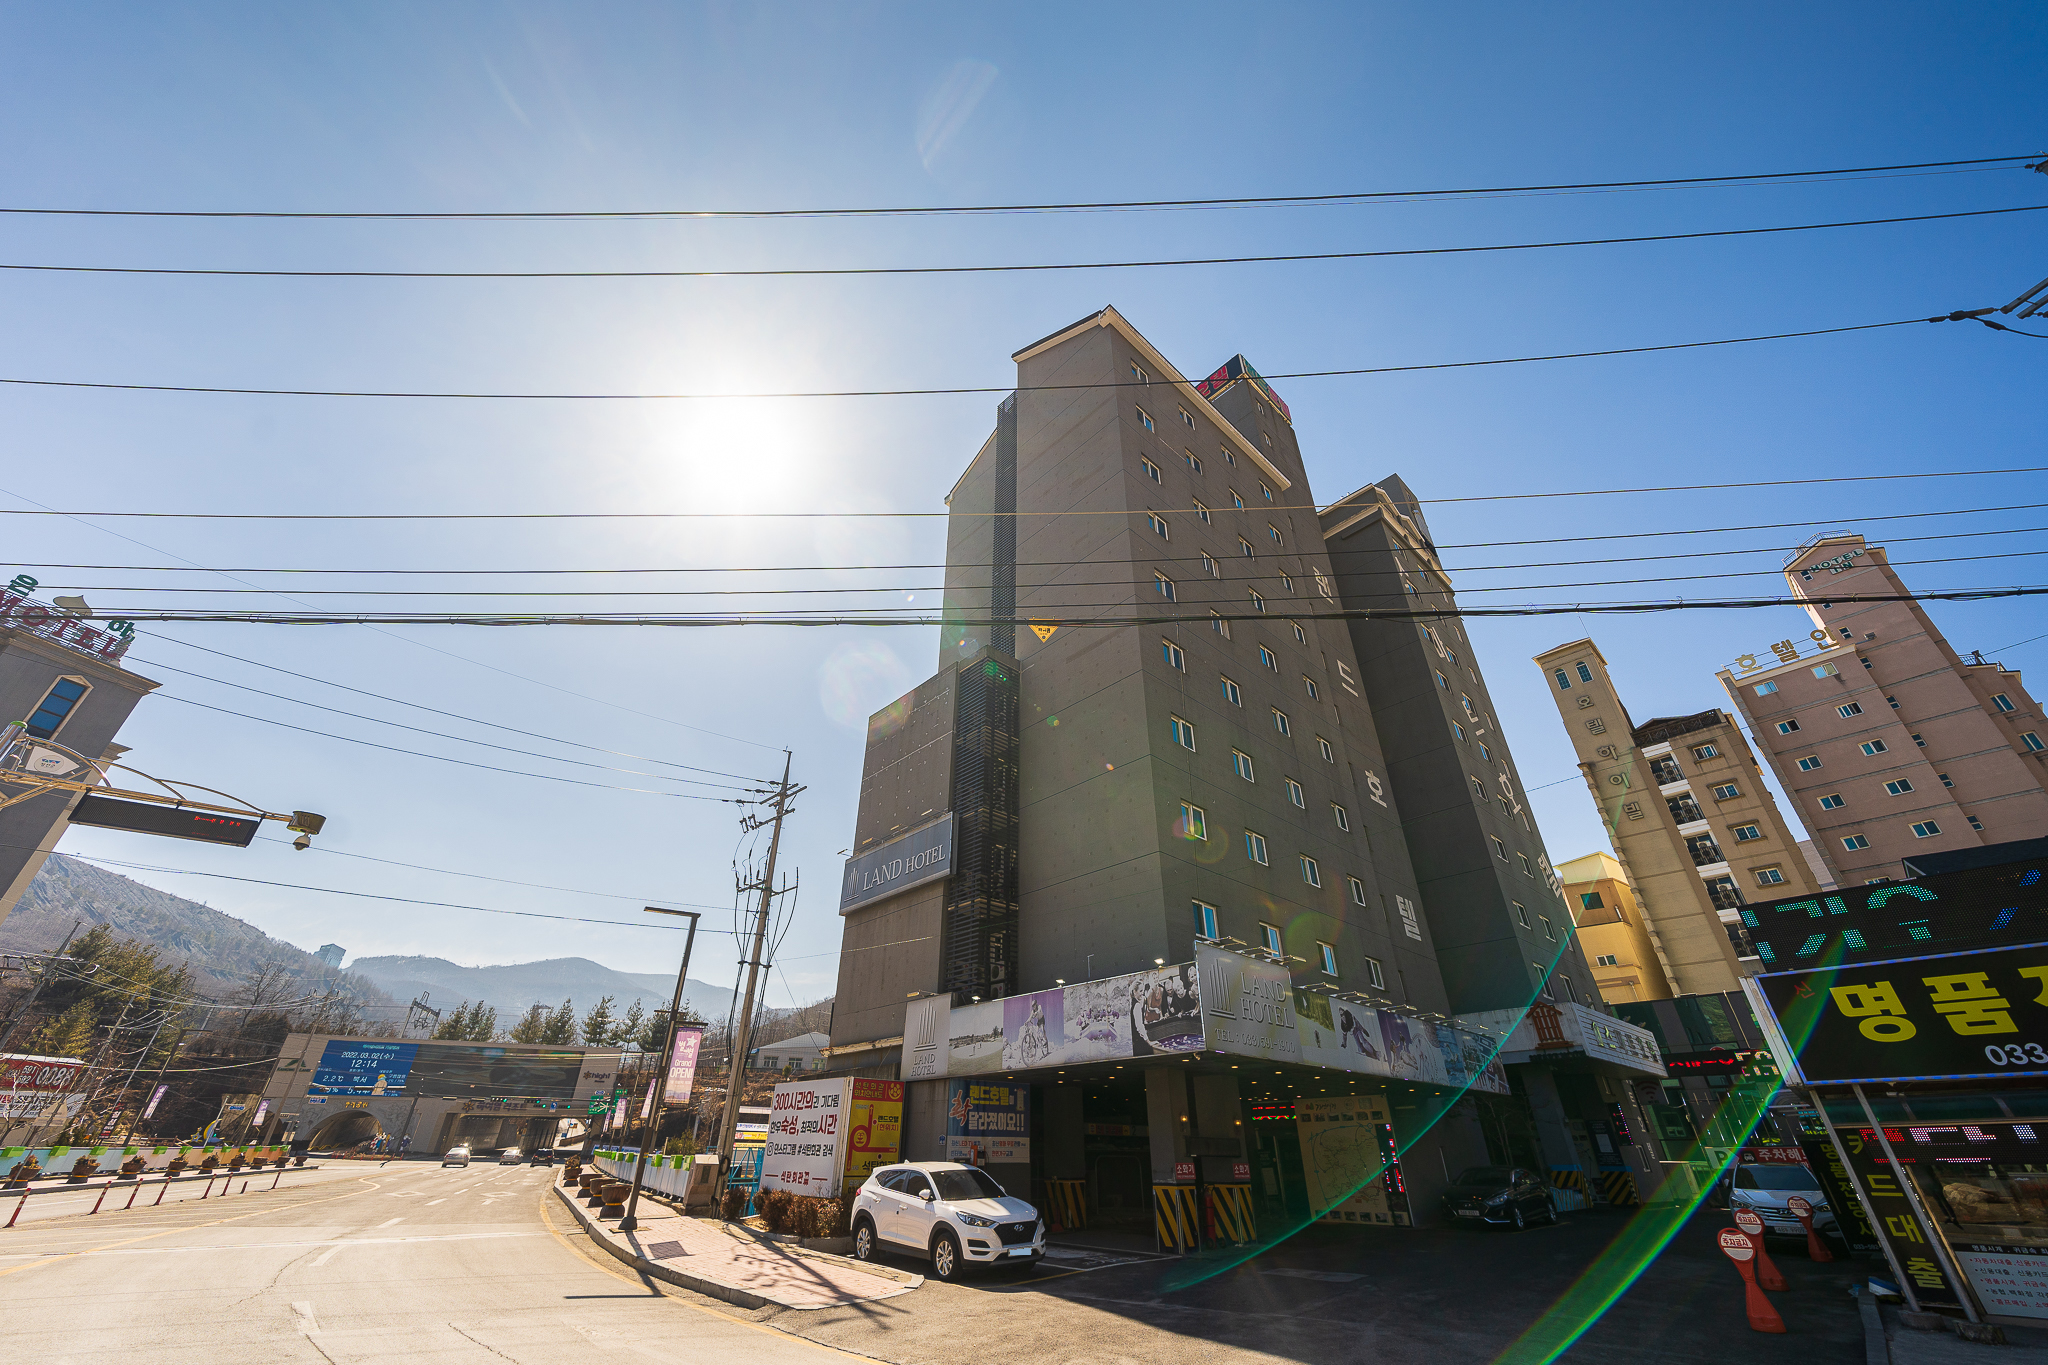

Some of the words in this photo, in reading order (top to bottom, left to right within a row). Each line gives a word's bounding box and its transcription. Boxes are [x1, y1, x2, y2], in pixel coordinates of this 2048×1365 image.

[1810, 549, 1864, 573] HOTEL
[862, 859, 902, 891] LAND
[905, 844, 946, 874] HOTEL
[1241, 972, 1286, 1002] LAND
[1240, 997, 1295, 1029] HOTEL
[1215, 1028, 1234, 1043] TEL
[913, 1053, 936, 1066] LAND
[1985, 1043, 2048, 1066] 033
[351, 1060, 378, 1068] 12:14
[674, 1059, 692, 1067] Grand
[669, 1067, 694, 1079] OPEN!
[911, 1065, 937, 1077] HOTEL
[821, 1094, 839, 1108] 기다림
[969, 1085, 1009, 1105] 랜드호텔
[949, 1089, 973, 1126] 확
[968, 1111, 1024, 1131] 달라졌어요!!
[774, 1143, 797, 1156] 인스타그램
[1177, 1164, 1195, 1174] 소화기
[1235, 1165, 1250, 1174] 소화기
[1722, 1237, 1749, 1247] 주차금지
